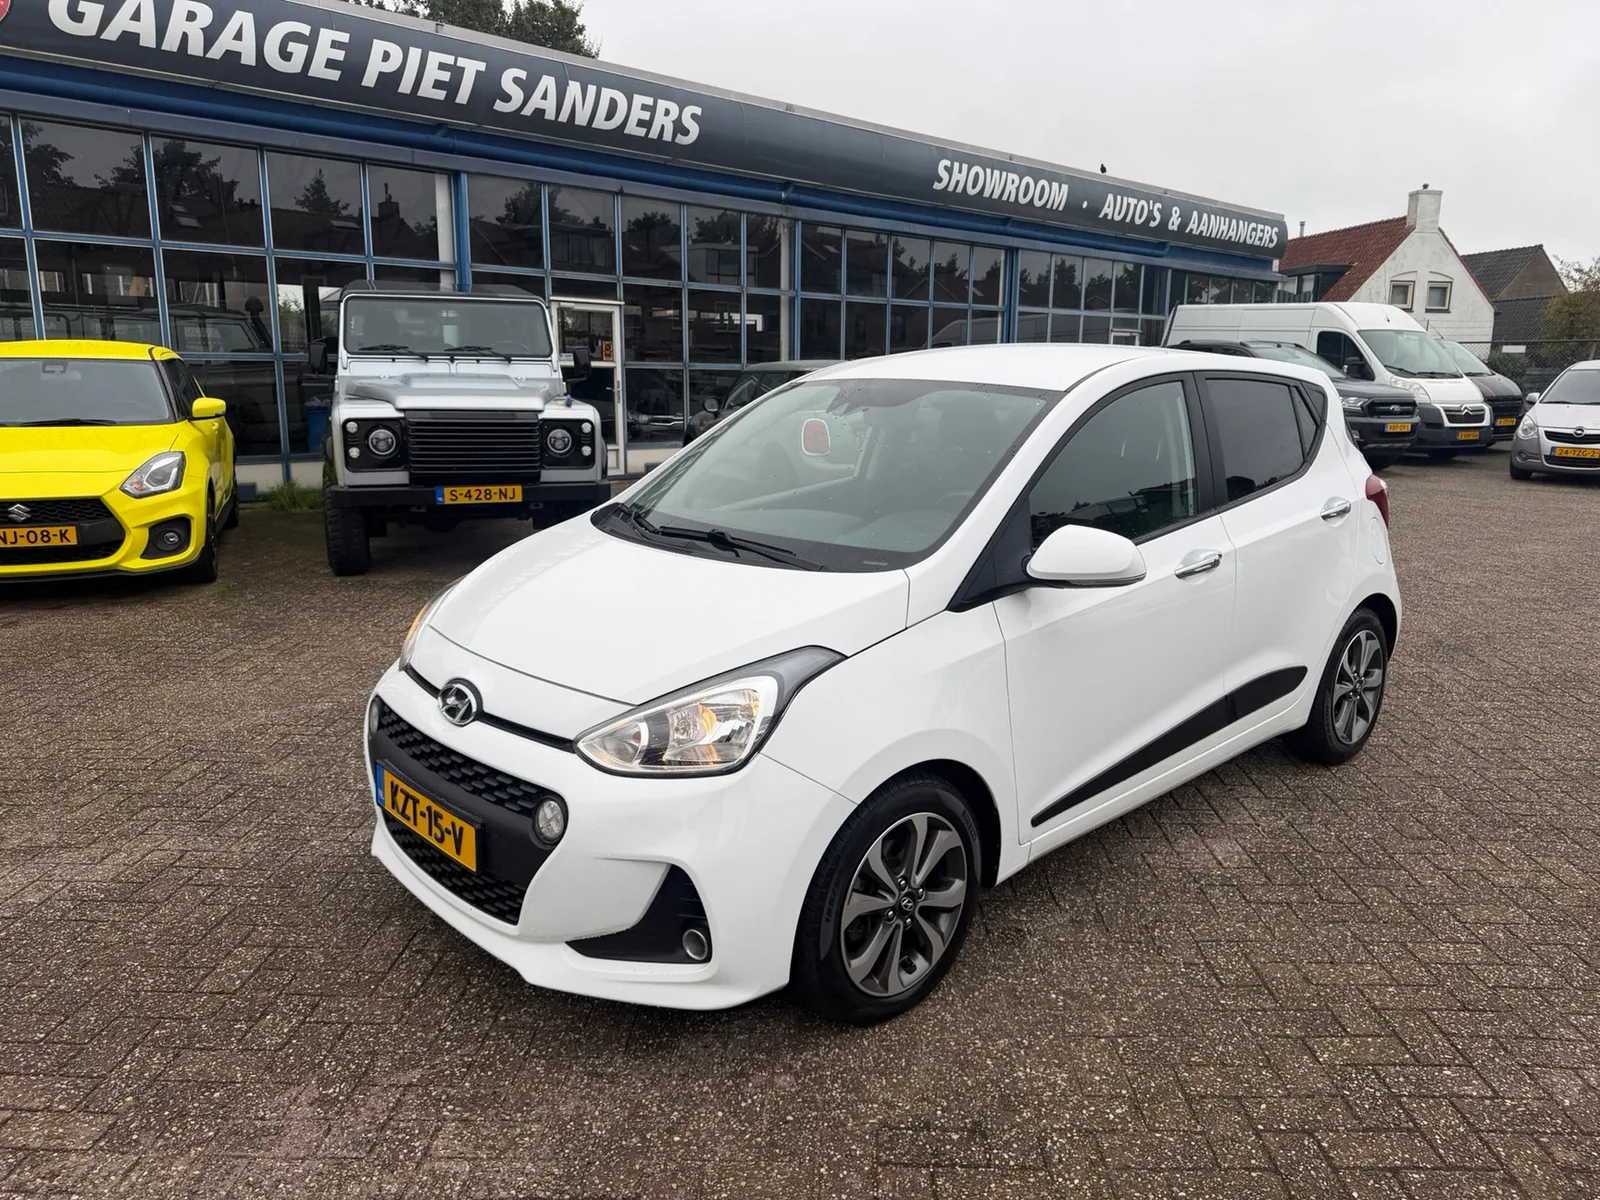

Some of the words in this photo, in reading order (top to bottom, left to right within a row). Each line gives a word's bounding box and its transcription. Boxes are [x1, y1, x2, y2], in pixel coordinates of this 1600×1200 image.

[49, 0, 351, 81] GARAGE
[361, 39, 486, 105] PIET
[494, 68, 703, 145] SANDERS
[932, 159, 1069, 211] SHOWROOM
[1099, 193, 1163, 228] AUTO'S
[1168, 206, 1182, 231] &
[1185, 210, 1279, 249] AANHANGERS
[1558, 448, 1596, 457] 24-TZG-2
[449, 487, 516, 502] S-428-NJ
[390, 780, 464, 856] KZT-15-V
